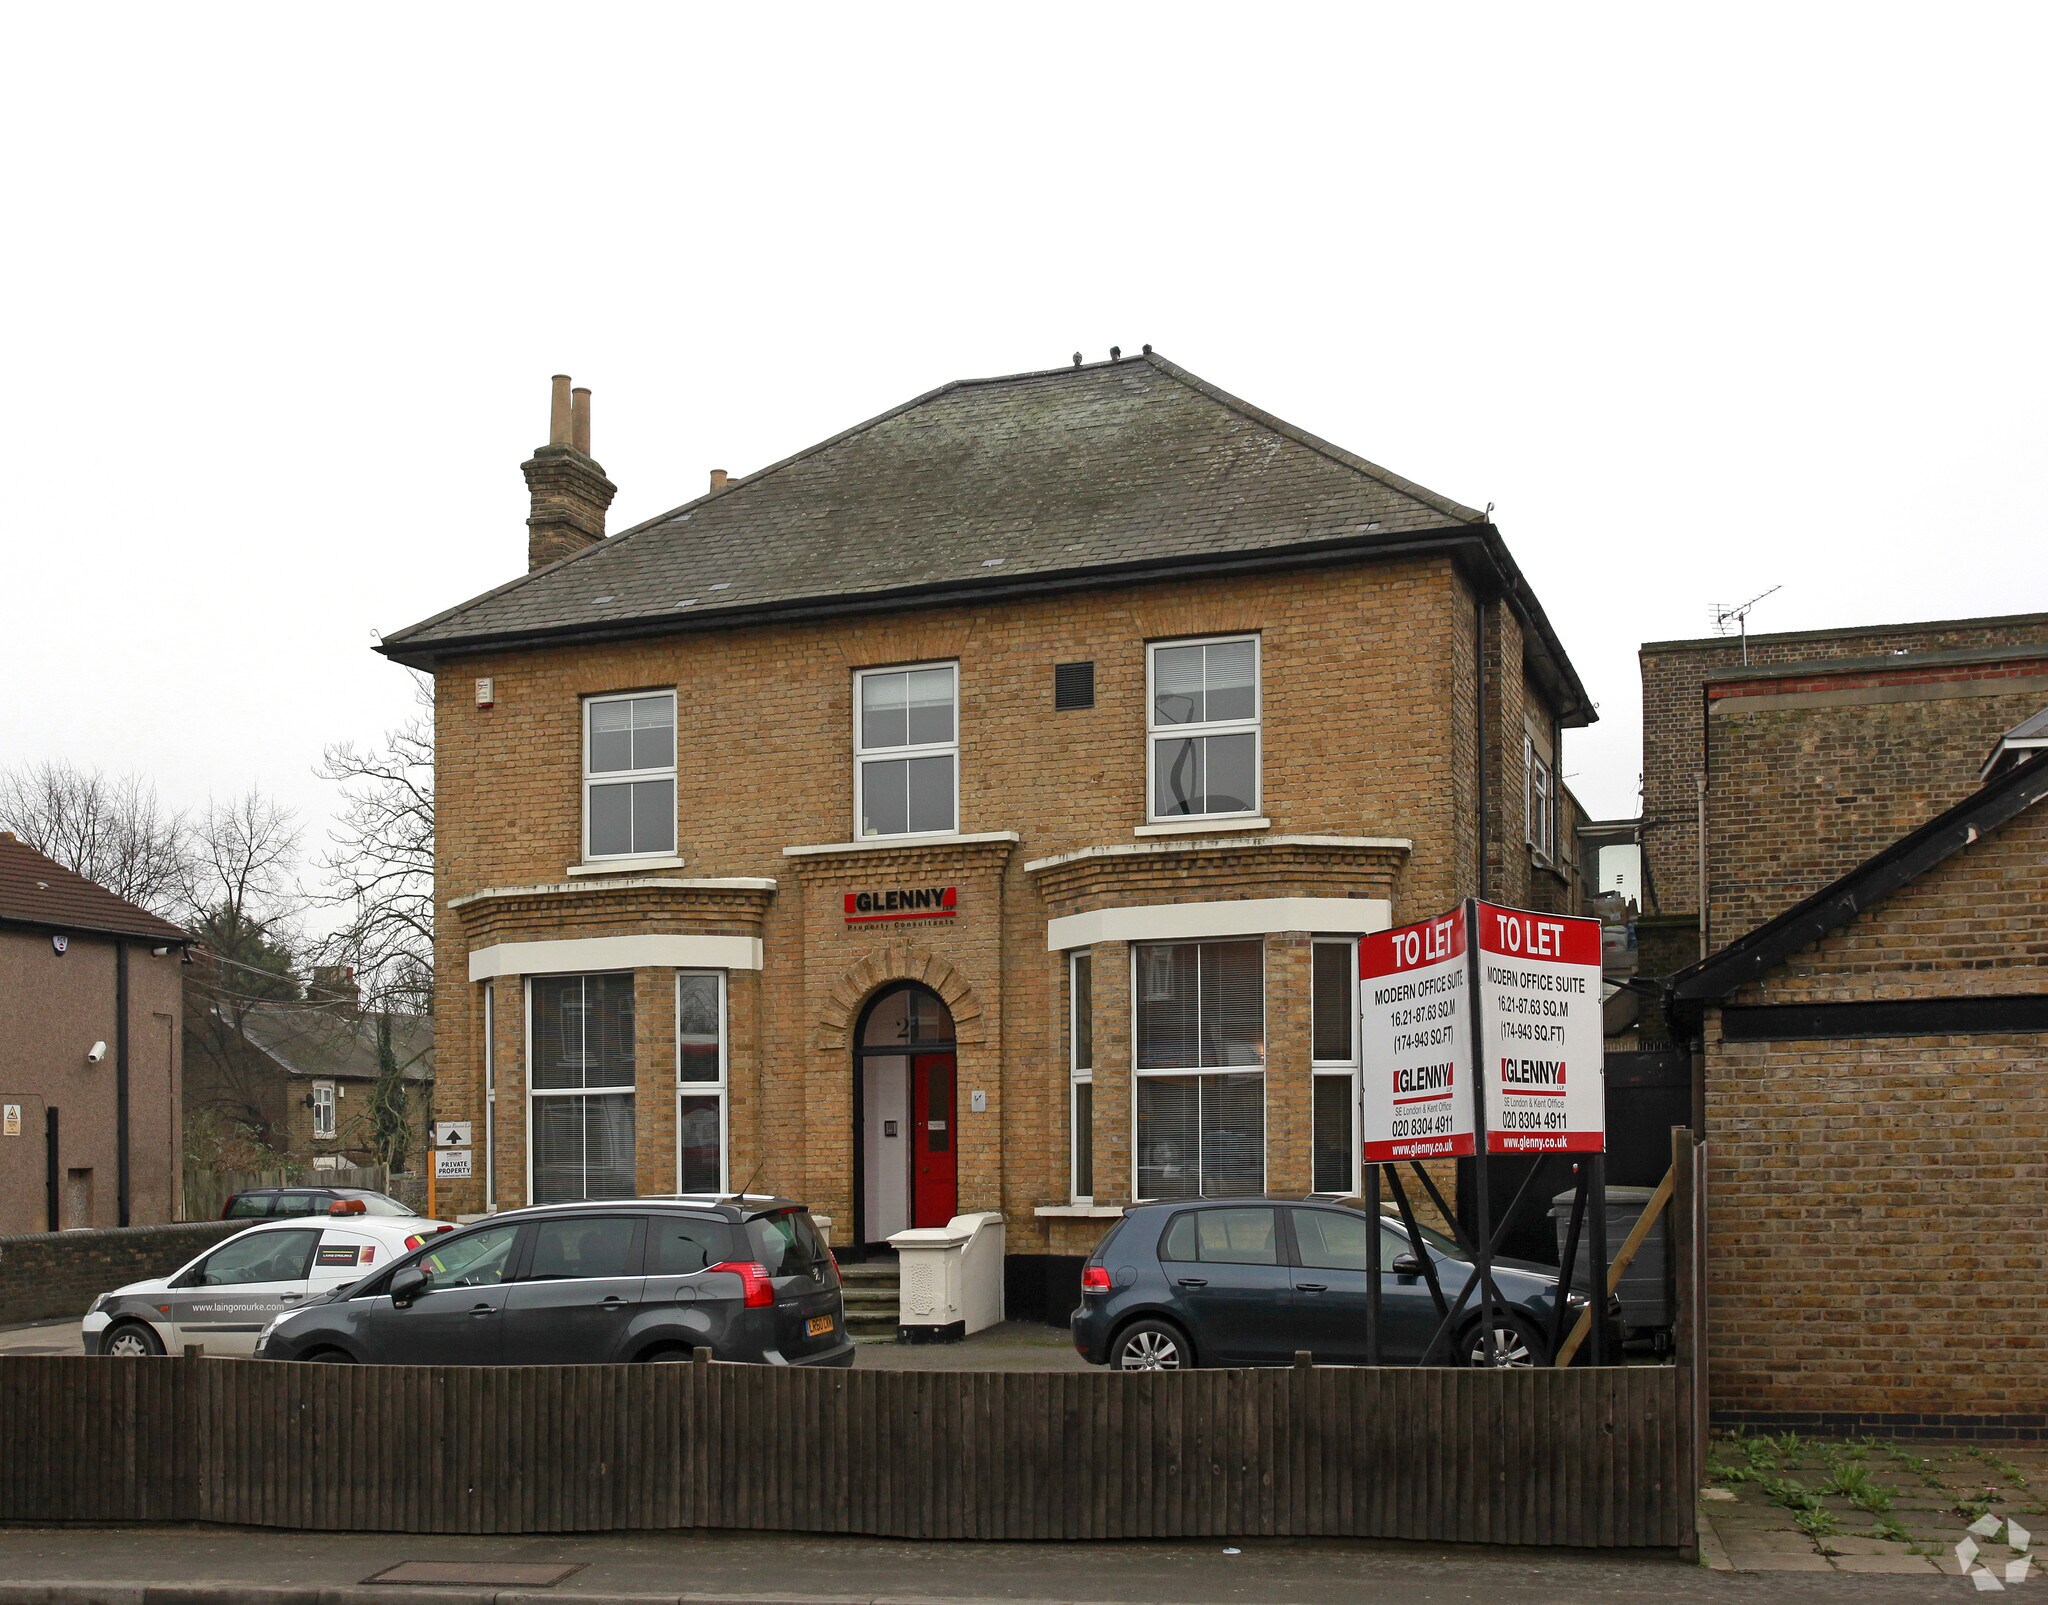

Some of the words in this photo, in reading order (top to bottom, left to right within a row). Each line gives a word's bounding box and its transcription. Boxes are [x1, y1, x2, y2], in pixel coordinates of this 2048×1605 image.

[856, 888, 945, 911] GLENNY
[847, 923, 889, 931] Property
[894, 918, 954, 928] Consultants
[1496, 914, 1521, 952] TO
[1525, 920, 1564, 957] LET
[1392, 931, 1420, 967] TO
[1425, 919, 1453, 961] LET
[1375, 983, 1416, 1005] MODERN
[1418, 976, 1446, 997] OFFICE
[1447, 969, 1463, 990] SUITE
[1487, 966, 1518, 987] MODERN
[1520, 972, 1553, 991] OFFICE
[1555, 976, 1585, 993] SUITE
[1391, 1004, 1437, 1027] 16.21-87.63
[1438, 999, 1455, 1018] SQ.M
[1498, 995, 1541, 1015] 16.21-87.63
[1543, 1000, 1568, 1017] SQ.M
[896, 1017, 909, 1038] 2
[1500, 1020, 1532, 1041] (174-943
[1534, 1024, 1565, 1046] SQ.FT)
[1394, 1031, 1428, 1054] (174-943
[1430, 1025, 1454, 1045] SQ.FT)
[1400, 1063, 1449, 1092] GLENNY
[1506, 1058, 1559, 1084] GLENNY
[1395, 1107, 1402, 1117] SE
[1403, 1105, 1421, 1116] London
[1422, 1104, 1426, 1113] &
[1427, 1103, 1438, 1113] Kent
[1439, 1102, 1452, 1111] Office
[1503, 1097, 1510, 1107] SE
[1511, 1097, 1528, 1108] London
[1529, 1099, 1533, 1108] &
[1534, 1098, 1546, 1108] Kent
[1547, 1099, 1564, 1108] Office
[1392, 1119, 1409, 1137] 020
[1411, 1117, 1432, 1136] 8304
[1435, 1115, 1453, 1134] 4911
[1502, 1111, 1517, 1128] 020
[1519, 1111, 1541, 1129] 8304
[1544, 1112, 1567, 1129] 4911
[1392, 1138, 1453, 1156] www.glenny.co.uk
[1503, 1135, 1567, 1151] www.glenny.co.uk
[192, 1302, 285, 1313] www.laingorourke.com
